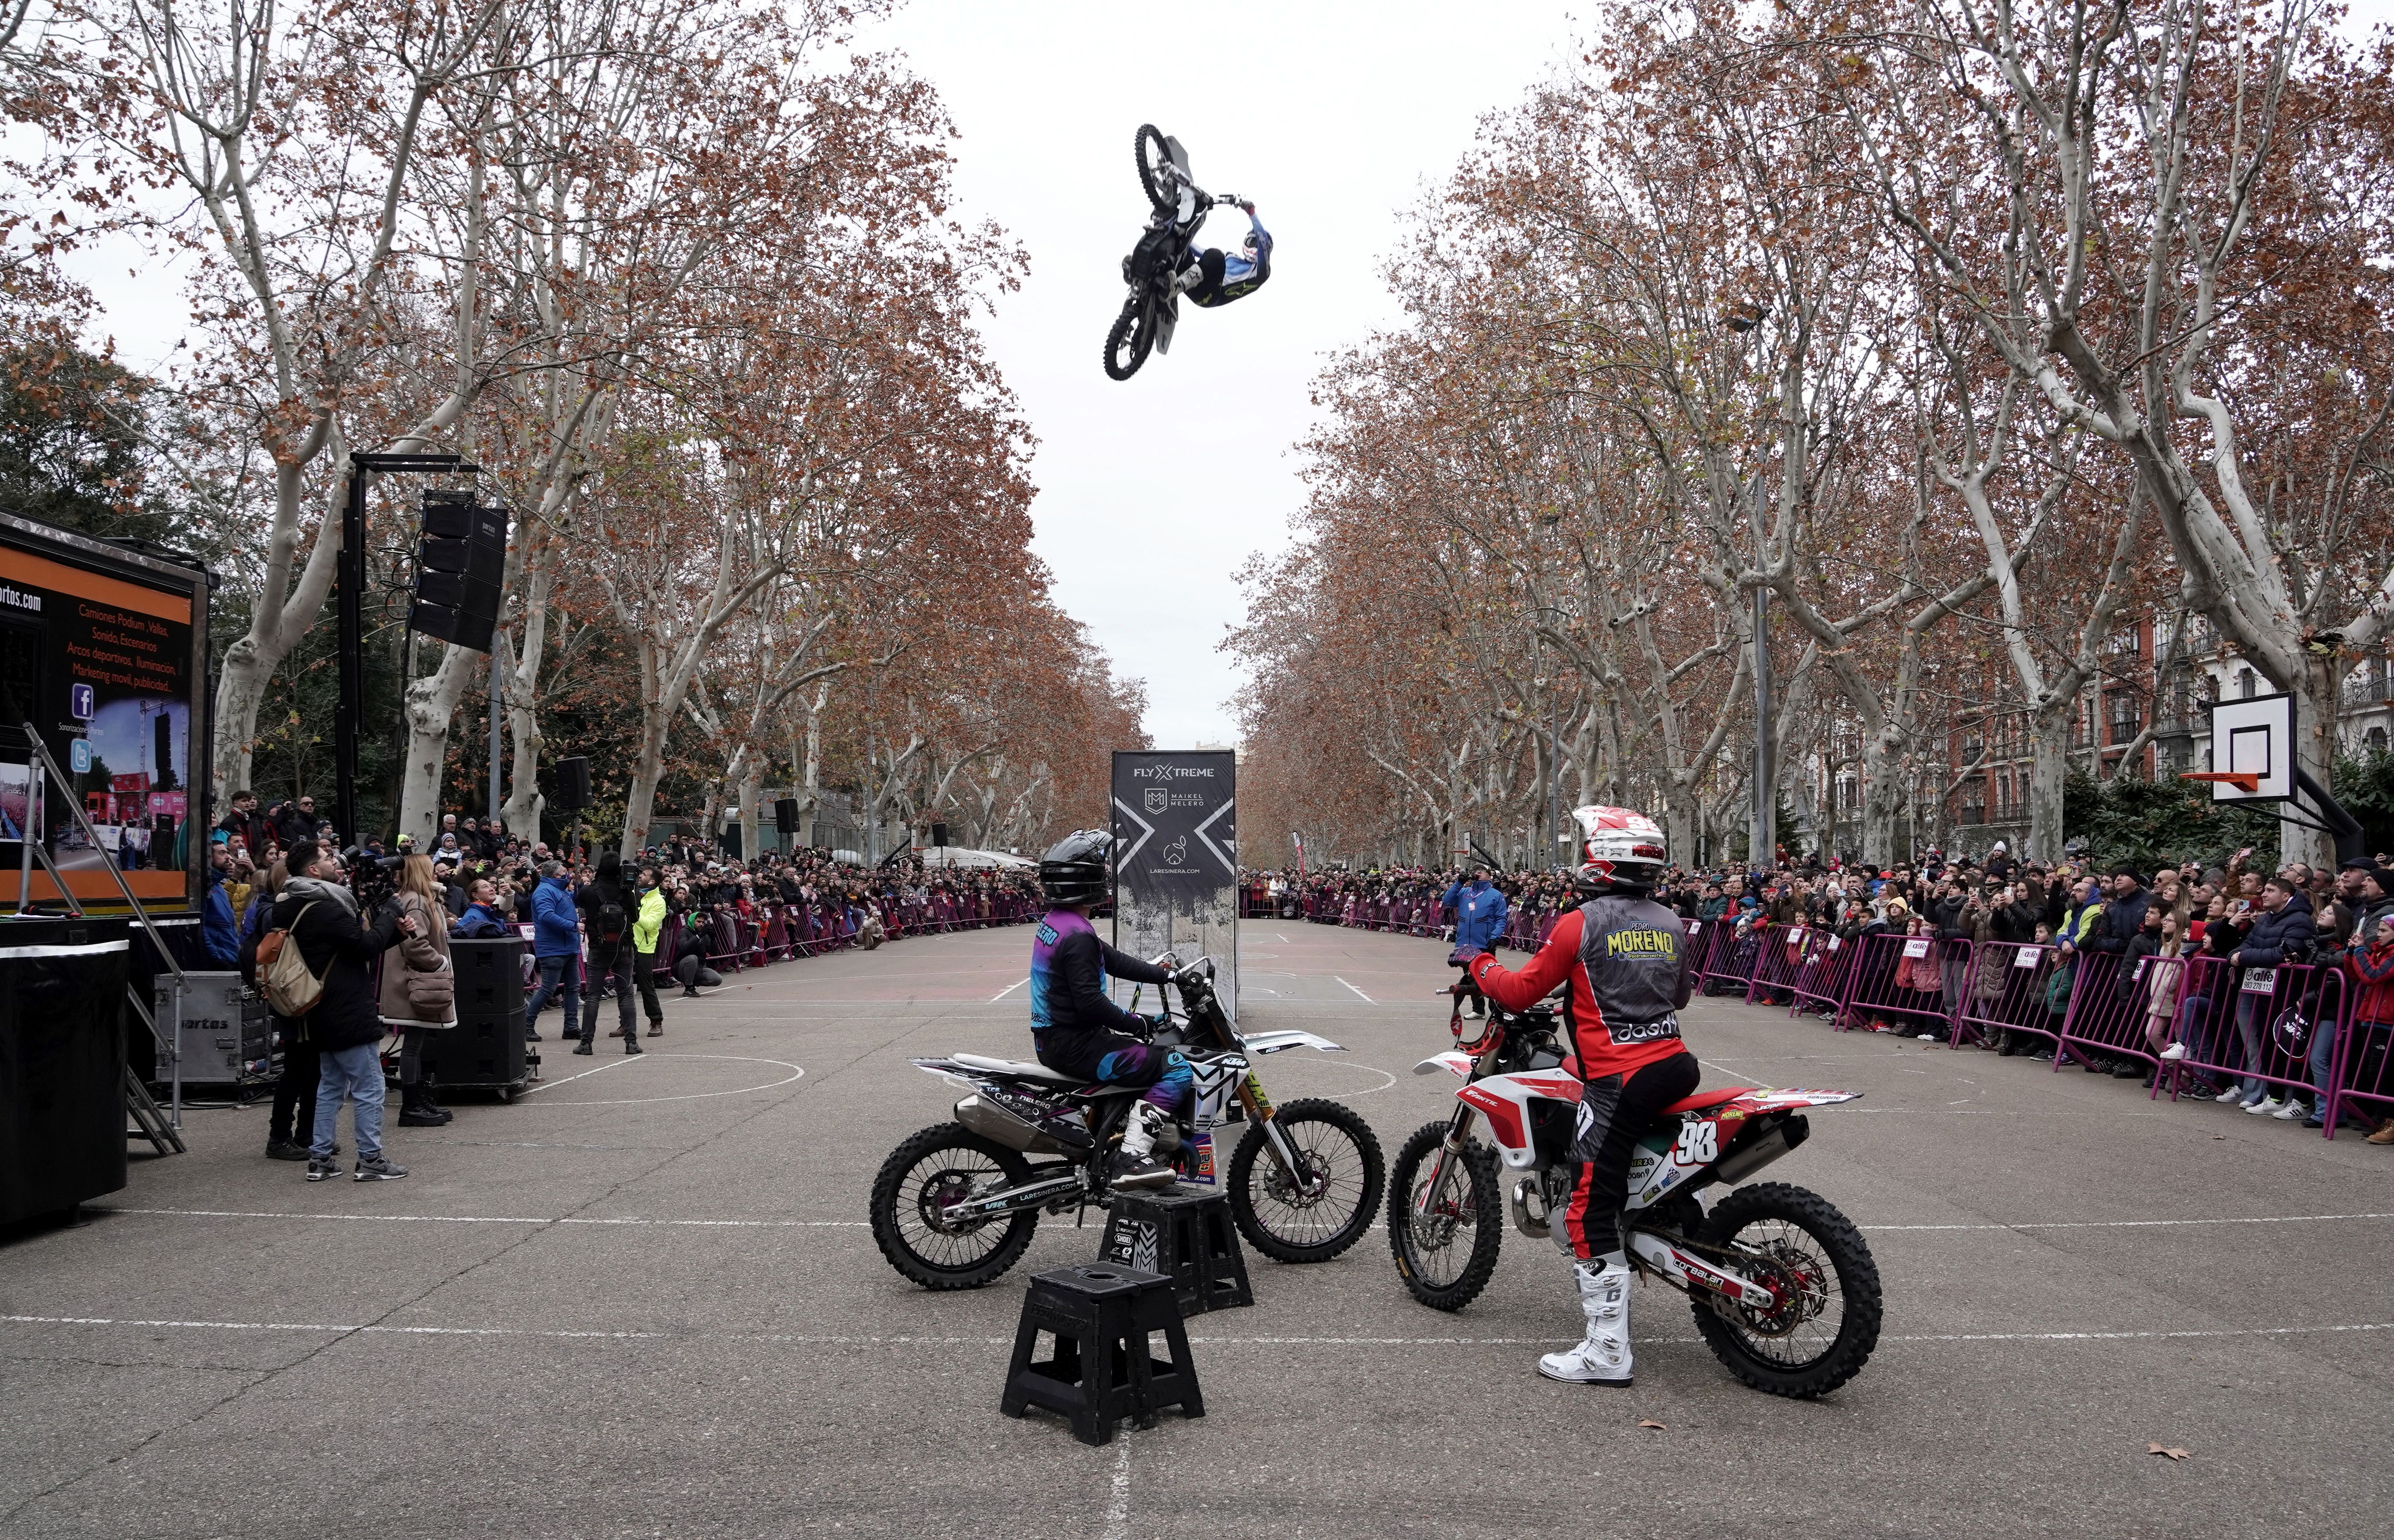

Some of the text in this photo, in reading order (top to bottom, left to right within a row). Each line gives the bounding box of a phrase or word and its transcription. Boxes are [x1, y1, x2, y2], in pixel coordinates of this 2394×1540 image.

[79, 604, 116, 624] Camiones
[117, 613, 145, 631] Podium
[92, 626, 157, 652] Sonido, Escenarios
[67, 641, 91, 657] Arcos
[92, 647, 133, 668] deportivos,
[72, 662, 110, 684] Marketing
[111, 673, 133, 686] movil,
[59, 722, 90, 734] Sonorizaciones
[1632, 845, 1665, 860] MORENO
[1630, 922, 1651, 931] PEDRO
[1606, 929, 1674, 957] MORENO
[2253, 970, 2274, 982] alfe
[1256, 1037, 1300, 1046] LARESINERA.COM
[1221, 1057, 1247, 1067] KTM
[1450, 1068, 1463, 1079] FANTIC
[1019, 1095, 1051, 1110] MELERO
[1465, 1090, 1498, 1107] FANTIC
[1721, 1111, 1743, 1119] MORENO
[1276, 1119, 1304, 1163] LARESINERA.COM
[1676, 1121, 1718, 1164] 98
[1020, 1182, 1076, 1201] LARESINERA.COM
[1117, 1235, 1131, 1244] SHOEI
